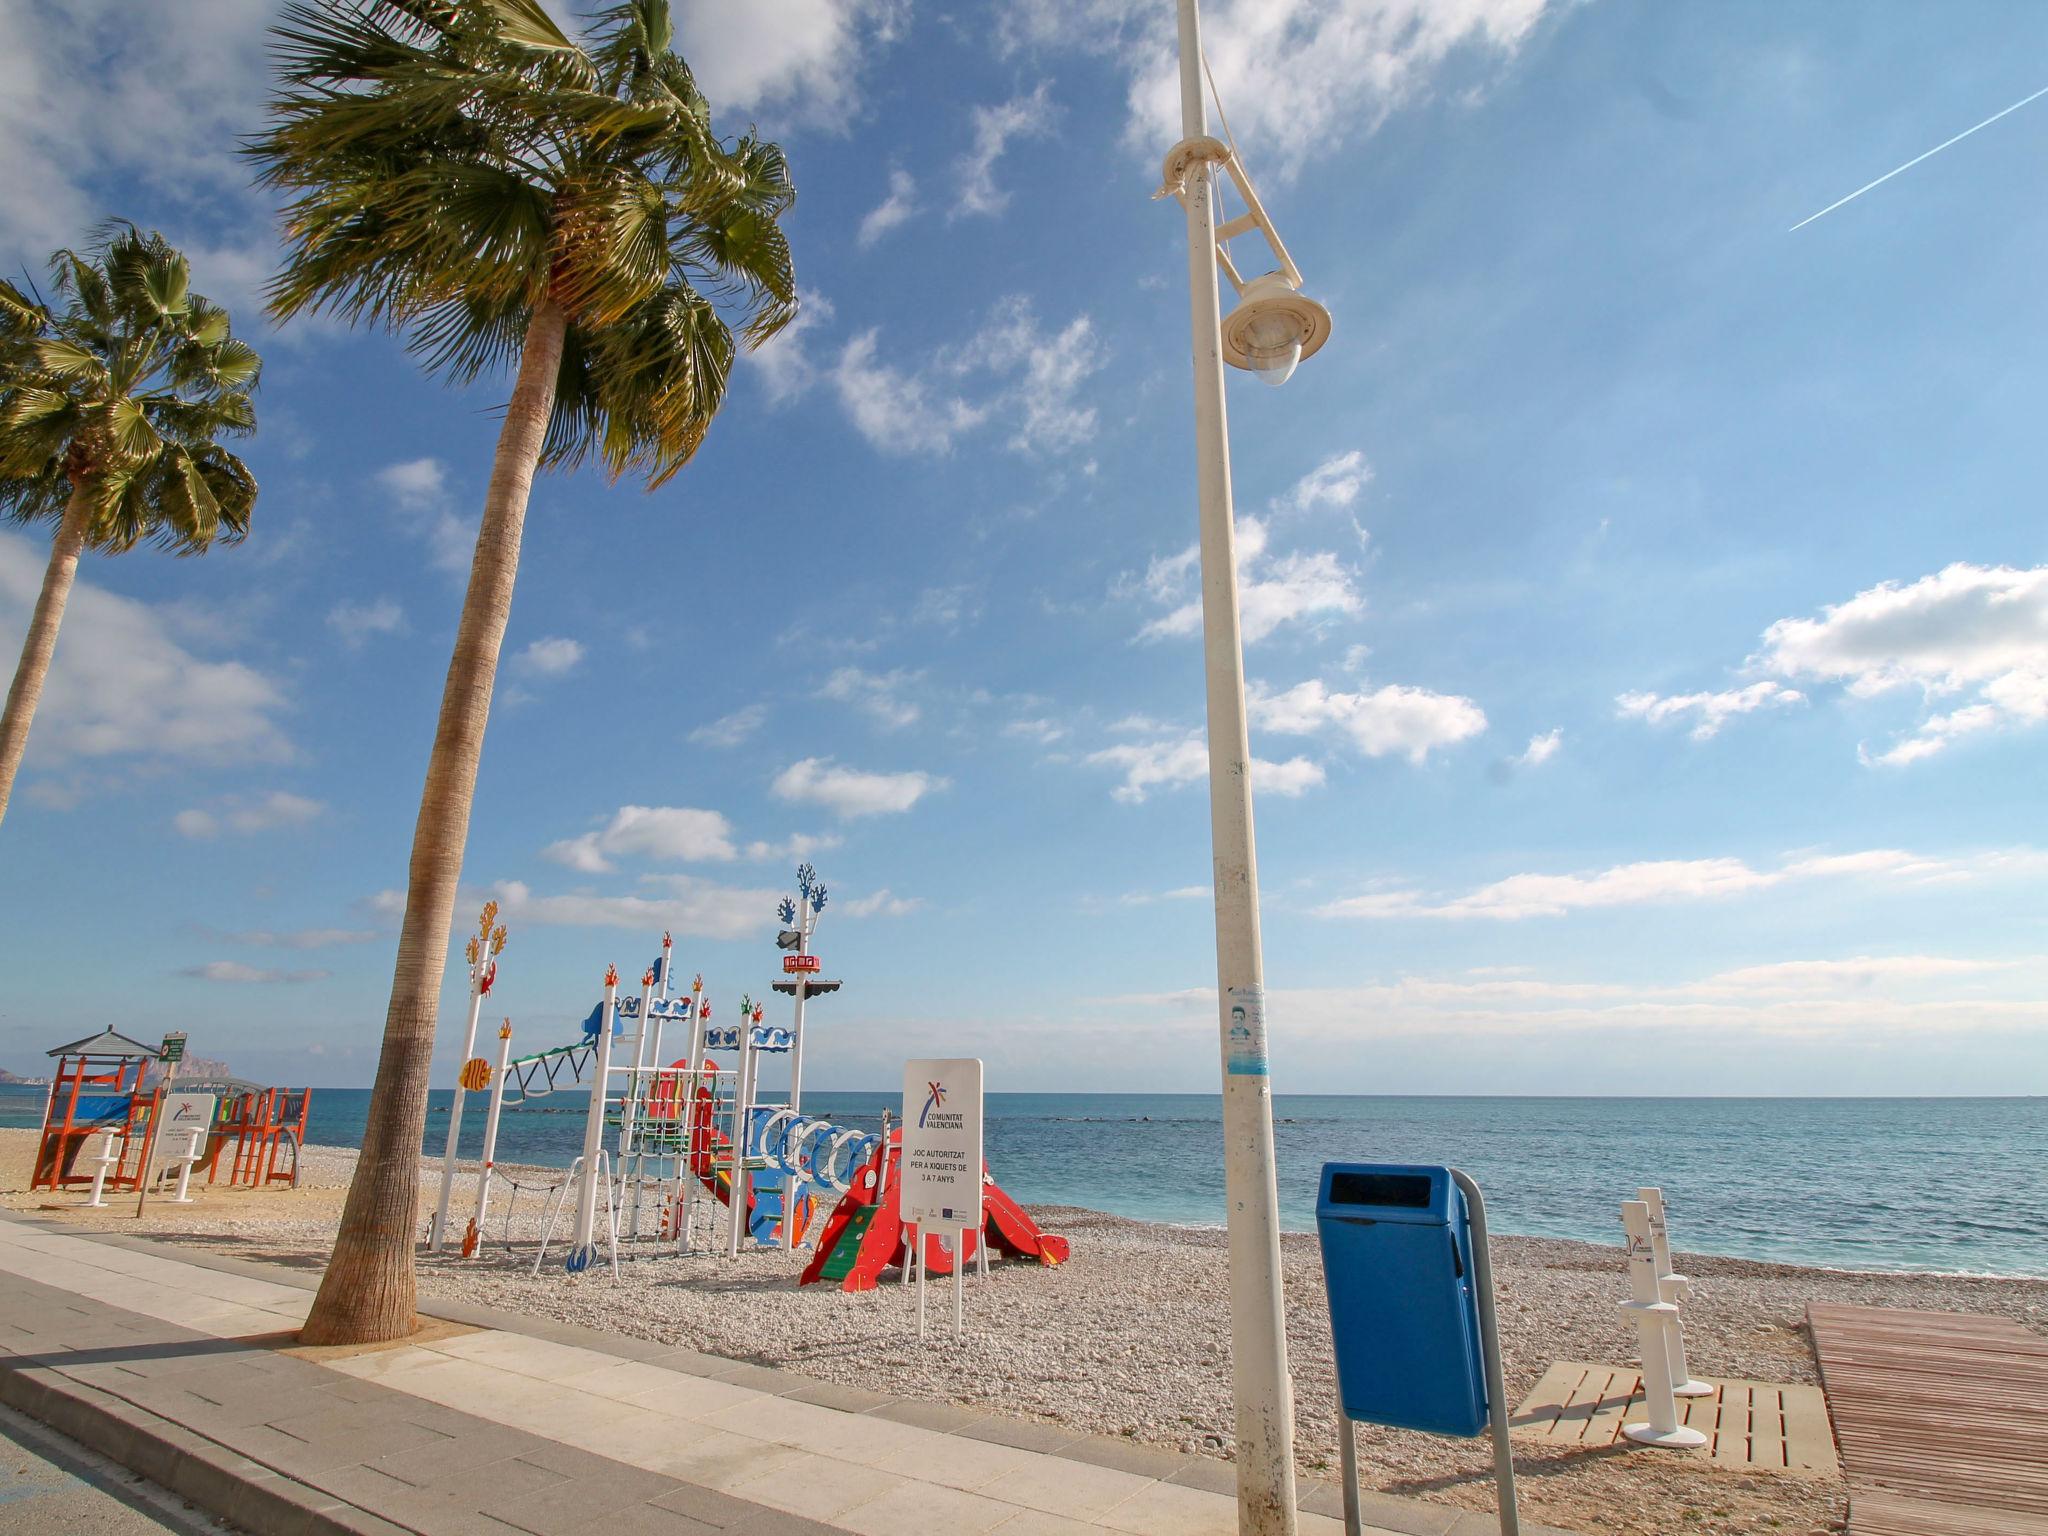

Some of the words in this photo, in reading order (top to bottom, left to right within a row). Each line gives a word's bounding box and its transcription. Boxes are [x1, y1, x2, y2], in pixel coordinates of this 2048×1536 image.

[928, 1113, 963, 1121] COMUNITAT
[926, 1121, 963, 1130] VALENCIANA
[926, 1150, 965, 1159] AUTORITZAT
[930, 1162, 957, 1171] XIQUETS
[937, 1175, 954, 1184] ANYS
